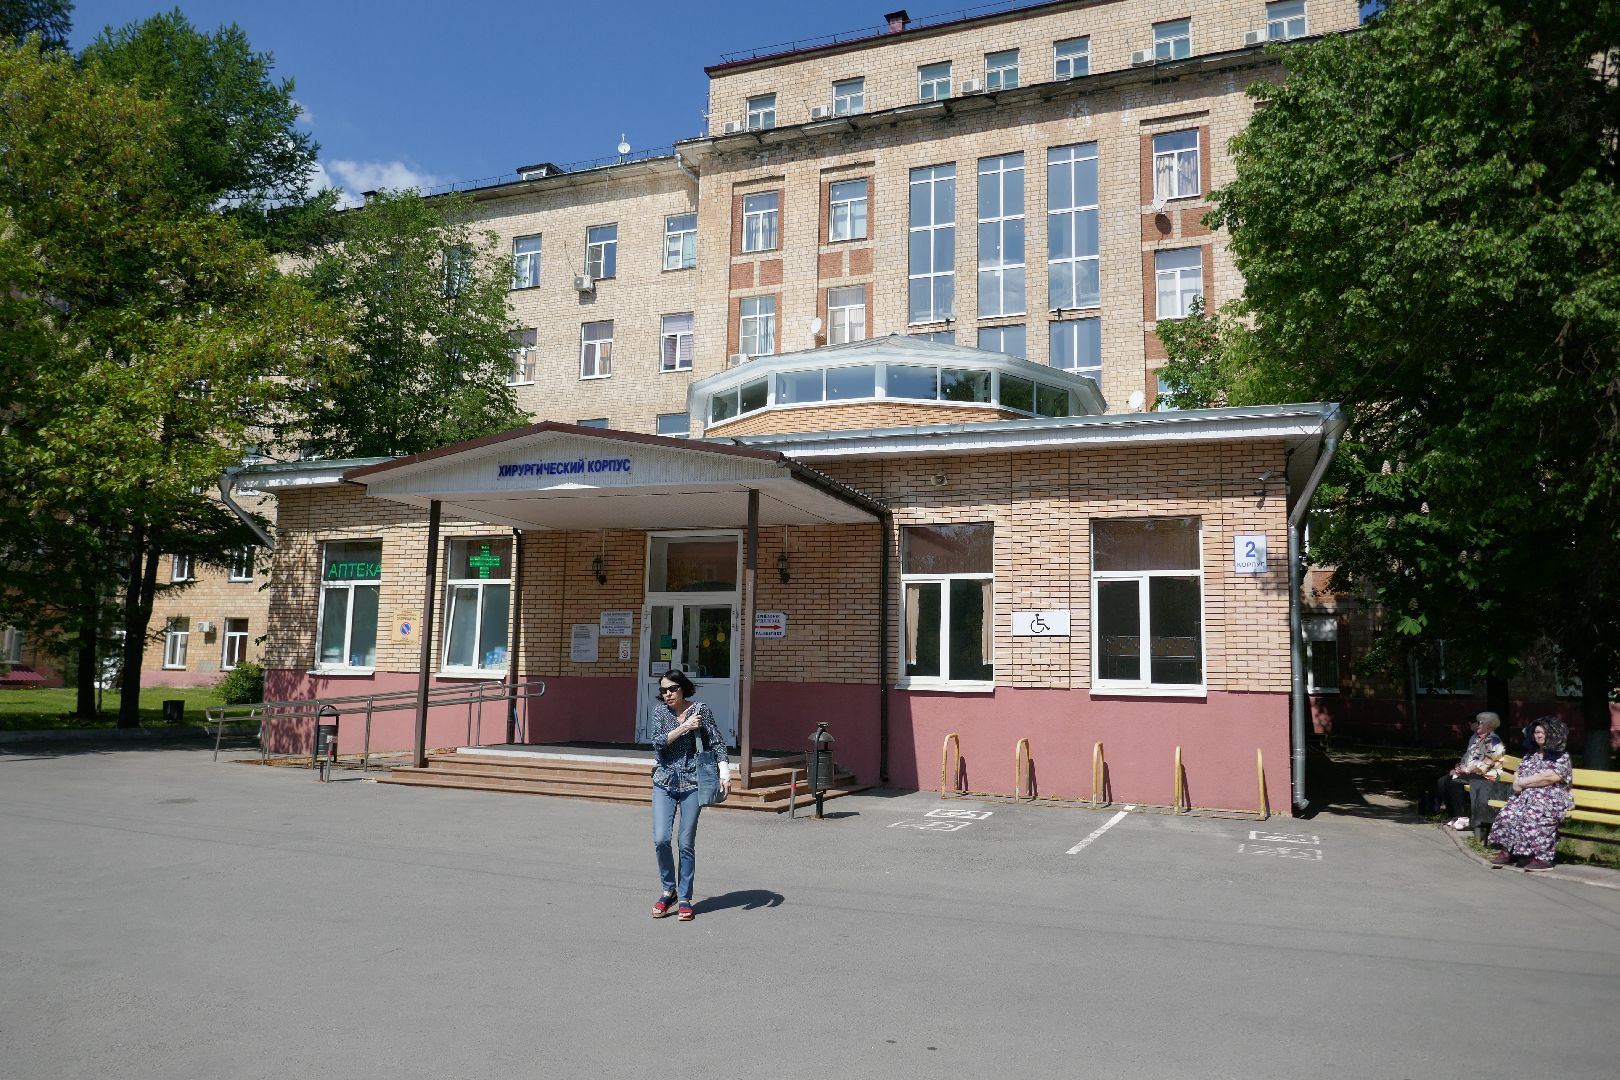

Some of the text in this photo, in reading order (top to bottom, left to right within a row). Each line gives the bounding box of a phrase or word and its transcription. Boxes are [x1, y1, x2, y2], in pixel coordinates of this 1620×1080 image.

[498, 458, 631, 477] ХИРУРГИЧЕСКИЙ КОРПУС
[1245, 540, 1256, 557] 2
[328, 563, 382, 577] АПТЕКА
